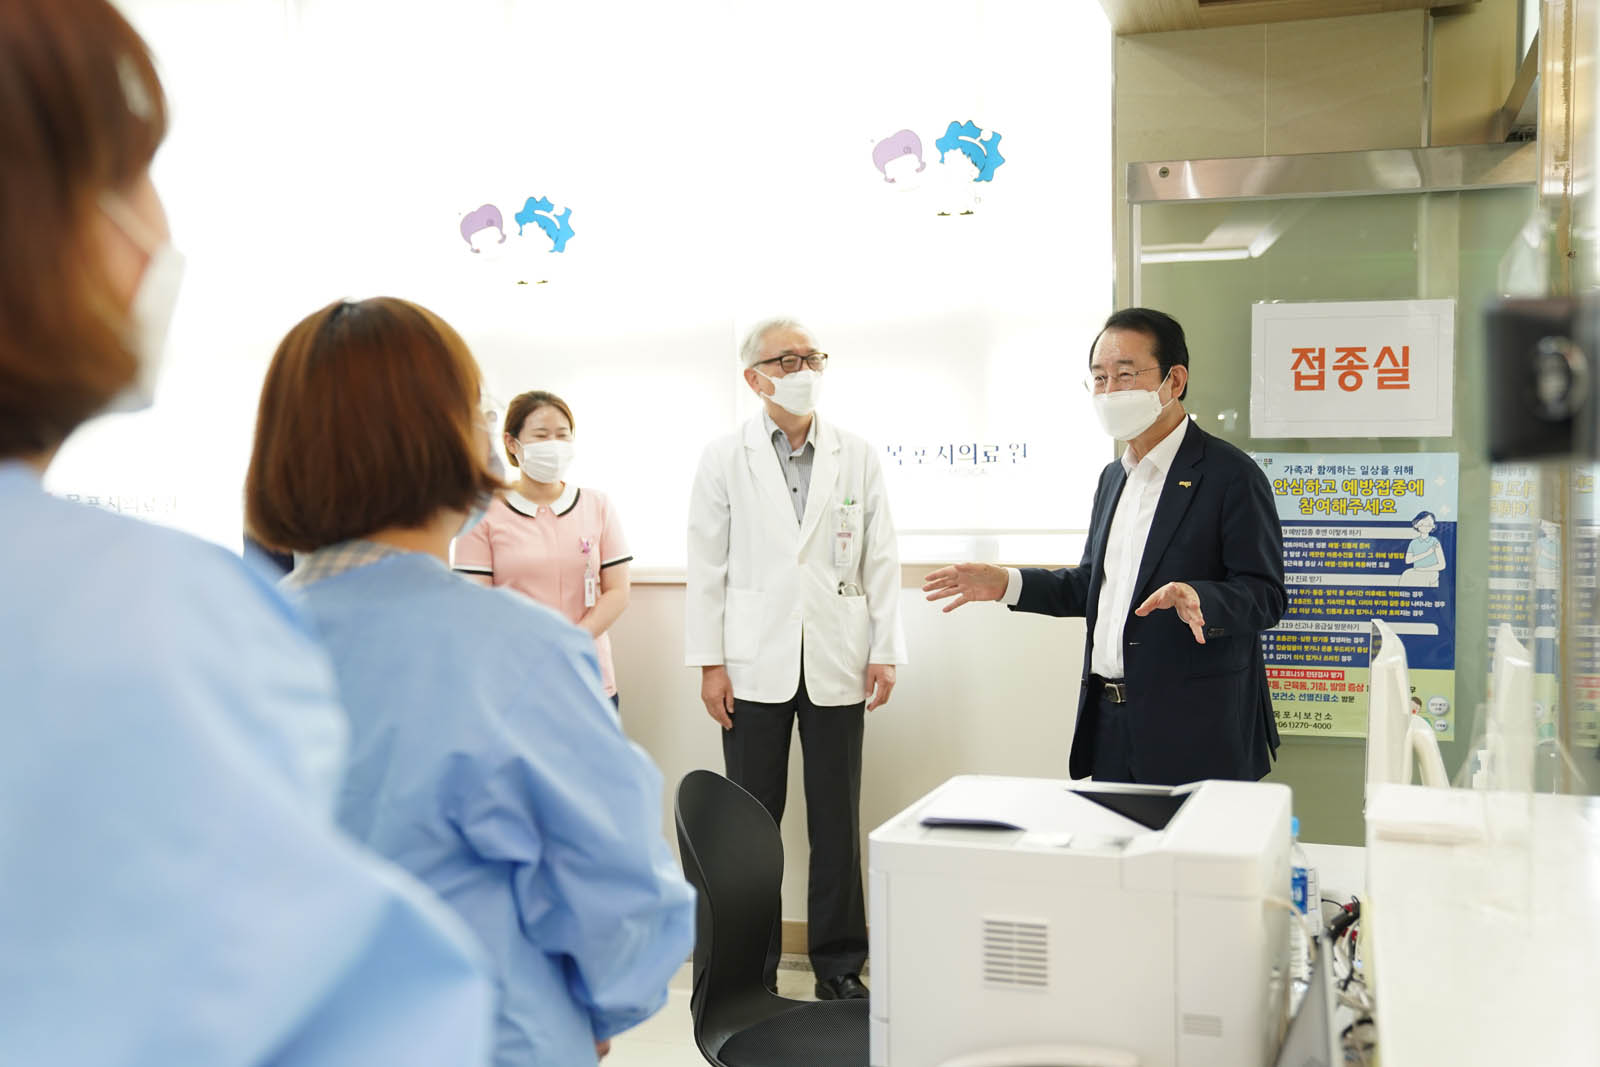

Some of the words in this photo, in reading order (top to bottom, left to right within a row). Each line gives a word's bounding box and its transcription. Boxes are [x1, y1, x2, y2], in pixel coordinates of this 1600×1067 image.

[1290, 345, 1410, 392] 접종실
[885, 443, 1028, 466] 목포시의료원
[1283, 465, 1313, 476] 가족과
[1317, 465, 1356, 476] 함께하는
[1360, 465, 1390, 476] 일상을
[1393, 465, 1414, 476] 위해
[1273, 478, 1338, 496] 안심하고
[1342, 478, 1424, 497] 예방접종에
[1299, 498, 1397, 516] 참여해주세요
[1289, 528, 1314, 537] 예방접종
[1328, 529, 1347, 537] 이렇게
[1349, 529, 1362, 537] 하기
[1295, 575, 1308, 583] 진료
[1308, 575, 1322, 584] 받기
[1280, 622, 1294, 630] 119
[1295, 622, 1313, 631] 신고나
[1314, 623, 1333, 632] 응급실
[1334, 623, 1360, 633] 방문하기
[1279, 670, 1305, 678] 코로나19
[1306, 671, 1329, 679] 진단검사
[1330, 672, 1343, 680] 받기
[1330, 682, 1346, 692] 발열
[1347, 683, 1364, 693] 증상
[1271, 692, 1297, 702] 보건소
[1298, 693, 1339, 703] 선별진료소
[1341, 695, 1356, 704] 방문
